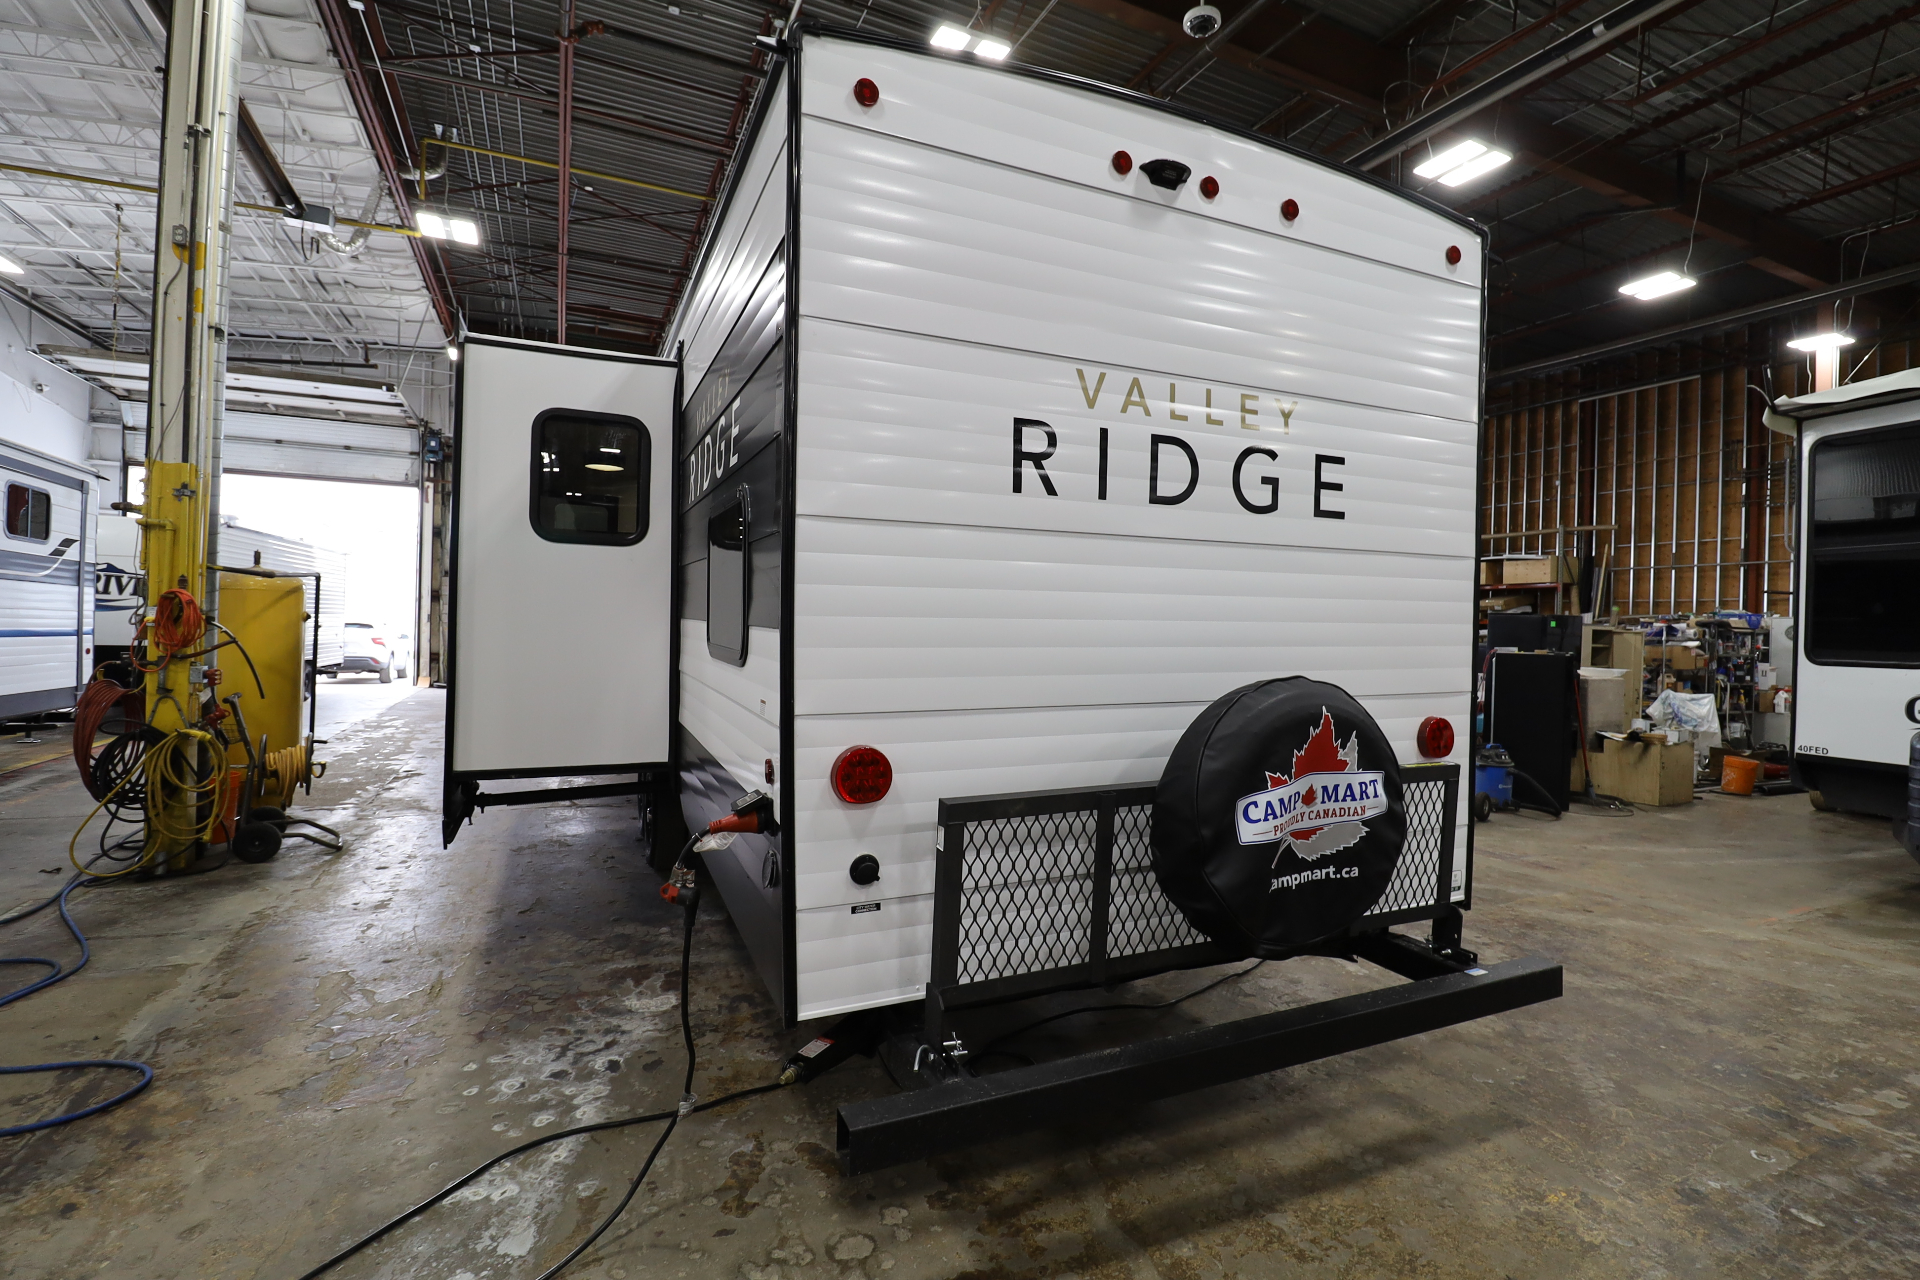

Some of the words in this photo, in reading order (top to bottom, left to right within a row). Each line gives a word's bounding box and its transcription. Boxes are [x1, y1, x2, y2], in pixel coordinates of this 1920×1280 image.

[1075, 367, 1299, 435] VALLEY
[688, 396, 741, 505] RIDGE
[1011, 416, 1347, 520] RIDGE
[95, 573, 141, 596] RIV
[1797, 744, 1829, 756] 40FED
[1242, 790, 1301, 824] CAMP
[1320, 778, 1379, 804] MART
[1273, 811, 1306, 837] PROUDLY
[1308, 804, 1367, 820] CANADIAN
